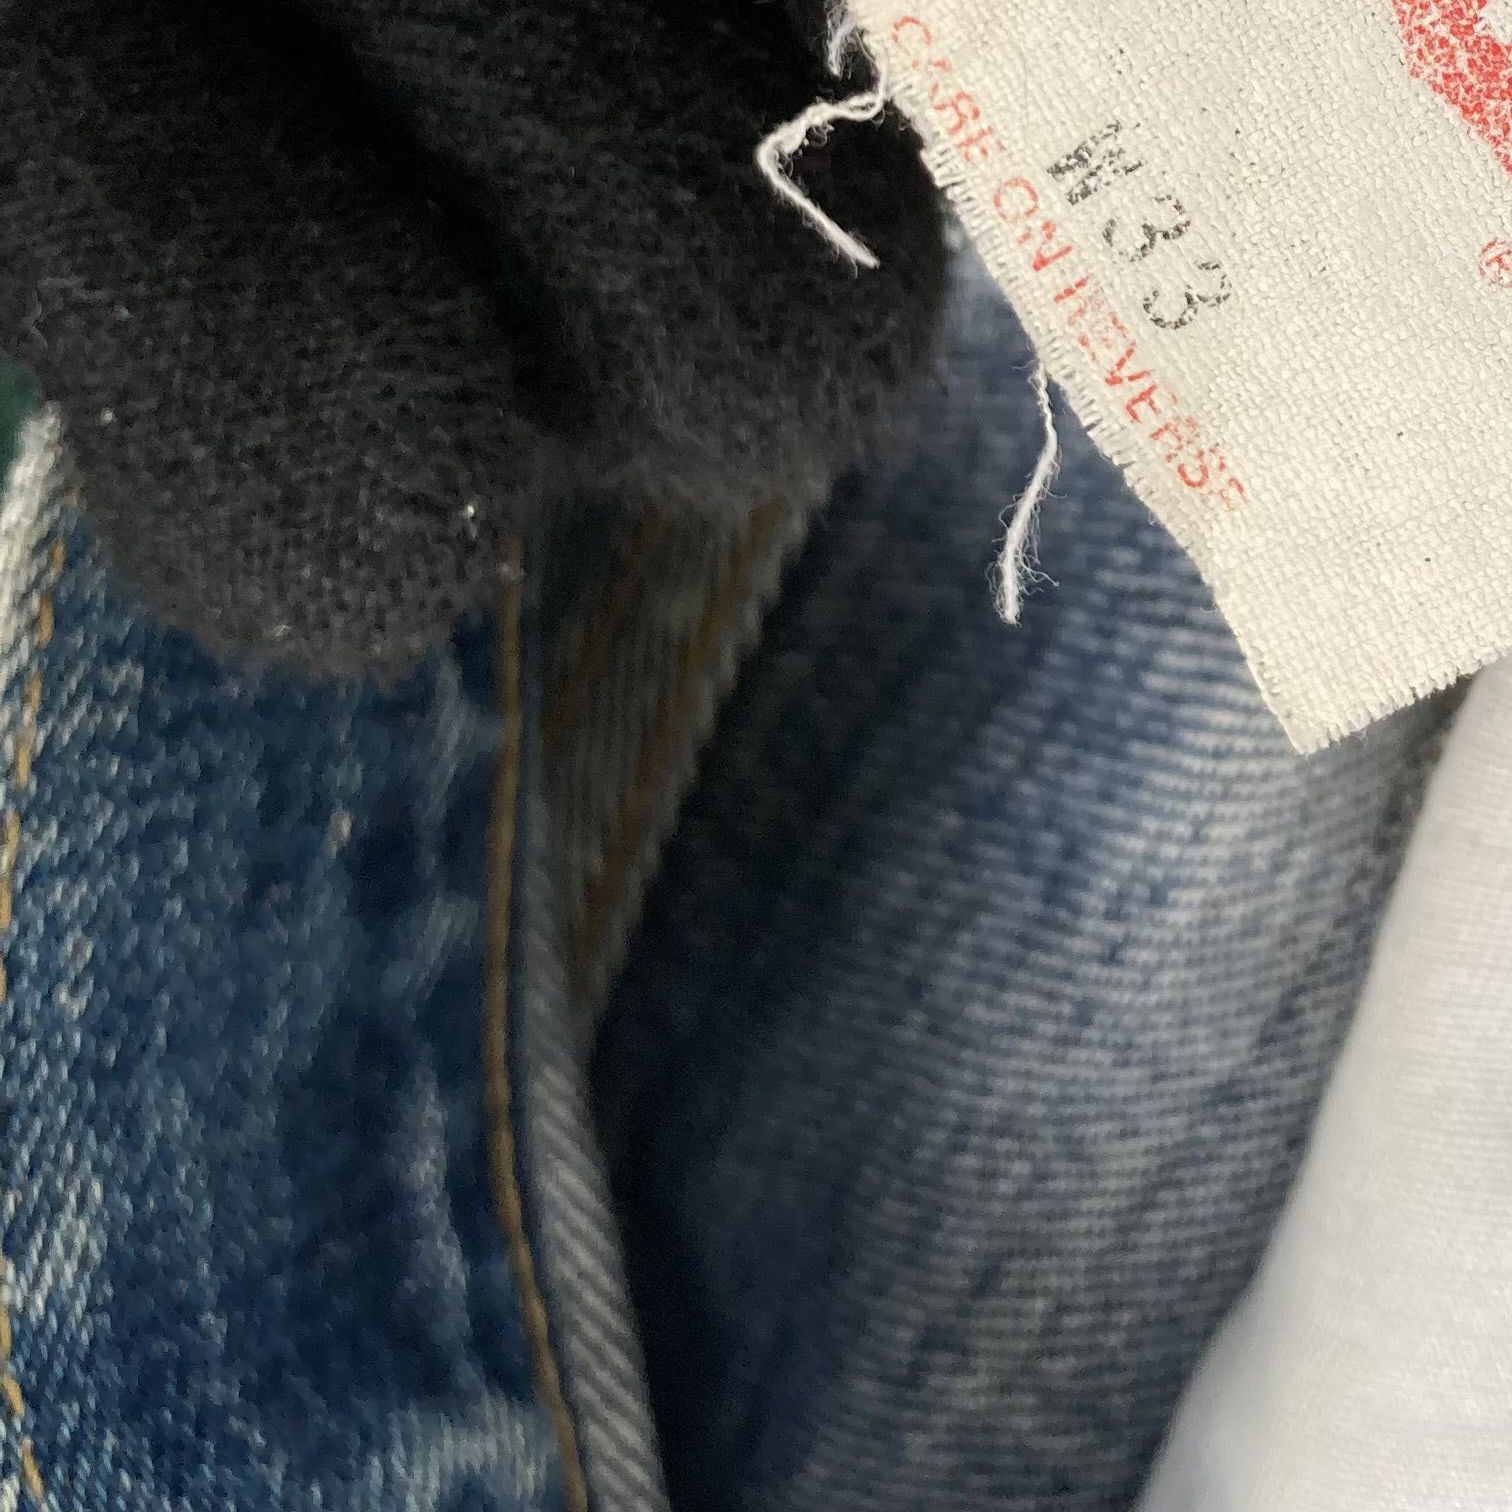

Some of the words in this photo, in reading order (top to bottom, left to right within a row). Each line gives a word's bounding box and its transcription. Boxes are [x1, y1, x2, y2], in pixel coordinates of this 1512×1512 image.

[891, 15, 1006, 164] CARE
[993, 176, 1073, 272] ON
[1046, 120, 1233, 330] W33
